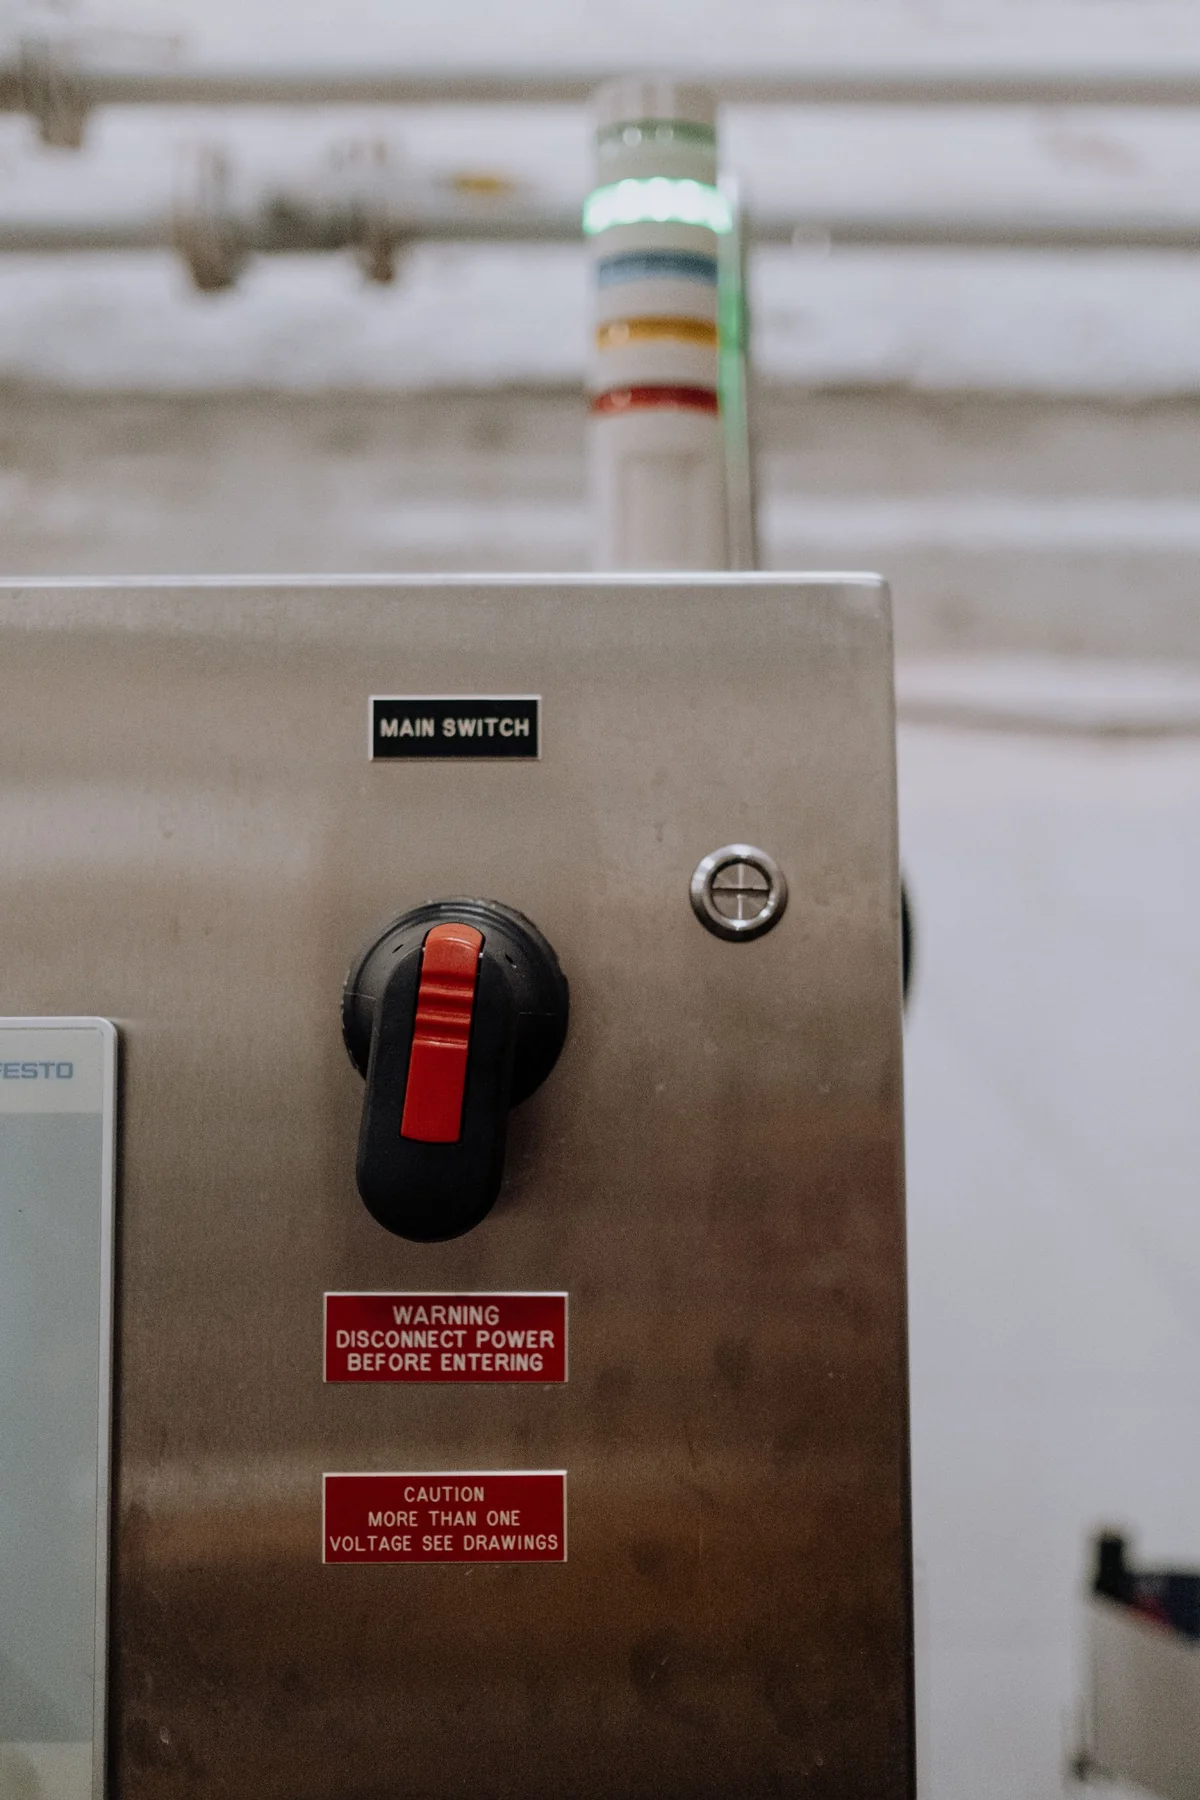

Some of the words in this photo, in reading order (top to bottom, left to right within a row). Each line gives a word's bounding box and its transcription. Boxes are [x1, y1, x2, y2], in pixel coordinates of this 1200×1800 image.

[380, 718, 435, 737] MAIN
[442, 717, 530, 737] SWITCH
[0, 1062, 74, 1079] ESTO
[393, 1305, 500, 1325] WARNING
[336, 1330, 467, 1348] DISCONNECT
[476, 1330, 555, 1348] POWER
[347, 1353, 432, 1372] BEFORE
[440, 1353, 544, 1372] ENTERING
[404, 1486, 485, 1502] CAUTION
[368, 1511, 418, 1527] MORE
[429, 1510, 477, 1526] THAN
[486, 1510, 521, 1526] ONE
[329, 1535, 412, 1551] VOLTAGE
[422, 1535, 454, 1551] SEE
[463, 1534, 558, 1550] DRAWINGS
